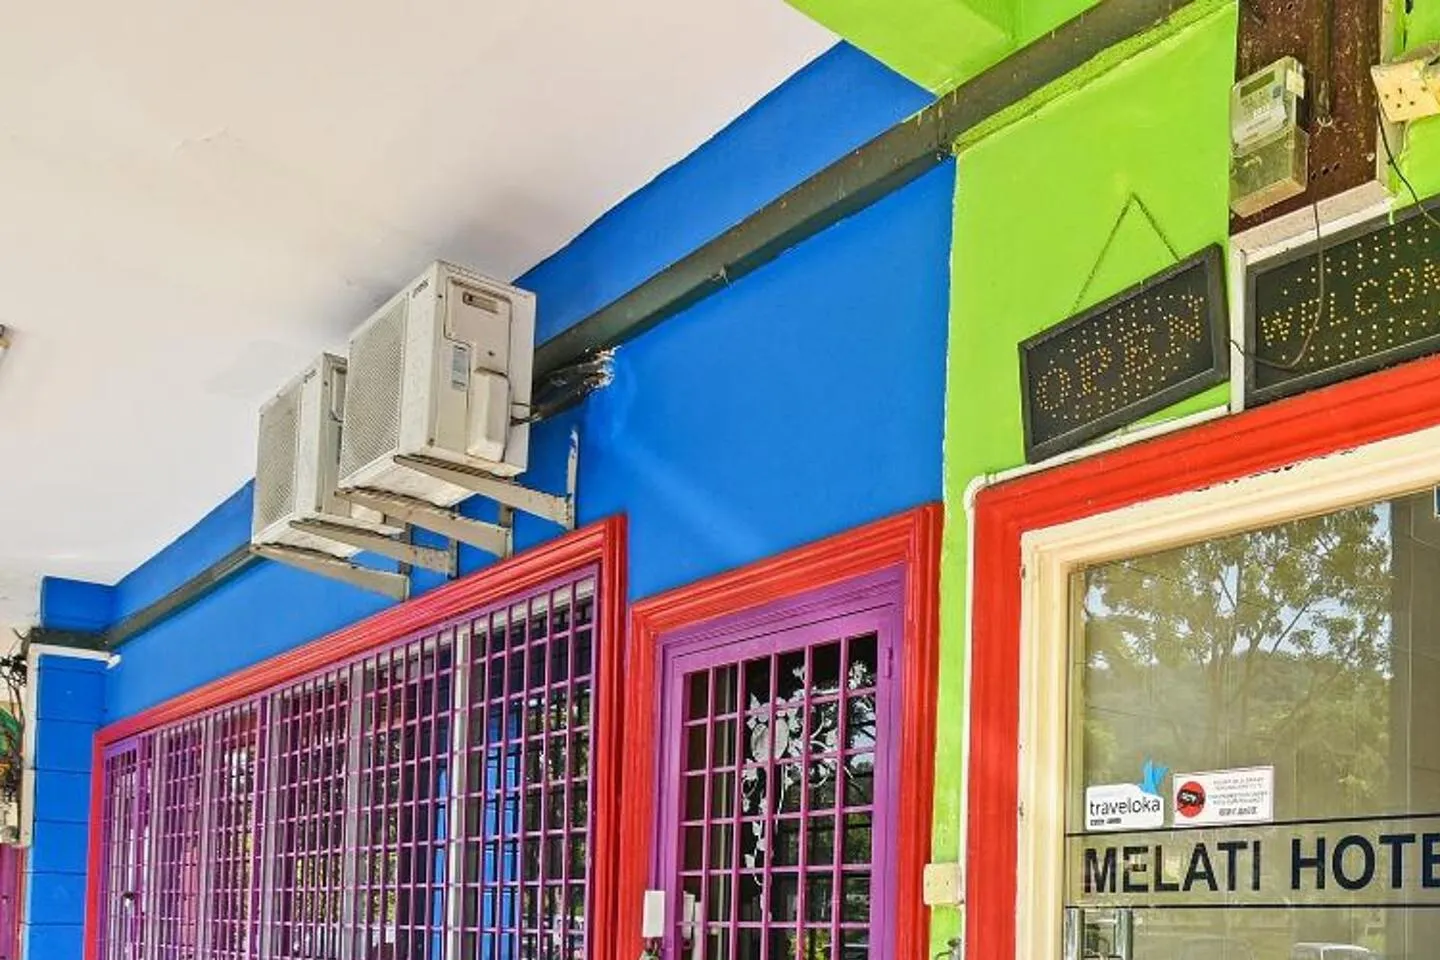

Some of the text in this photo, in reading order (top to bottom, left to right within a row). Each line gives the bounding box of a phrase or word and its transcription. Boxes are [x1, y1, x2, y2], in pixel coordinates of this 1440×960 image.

[1036, 294, 1205, 411] OPEN
[1090, 796, 1161, 816] traveloka
[1084, 840, 1260, 893] MELATI
